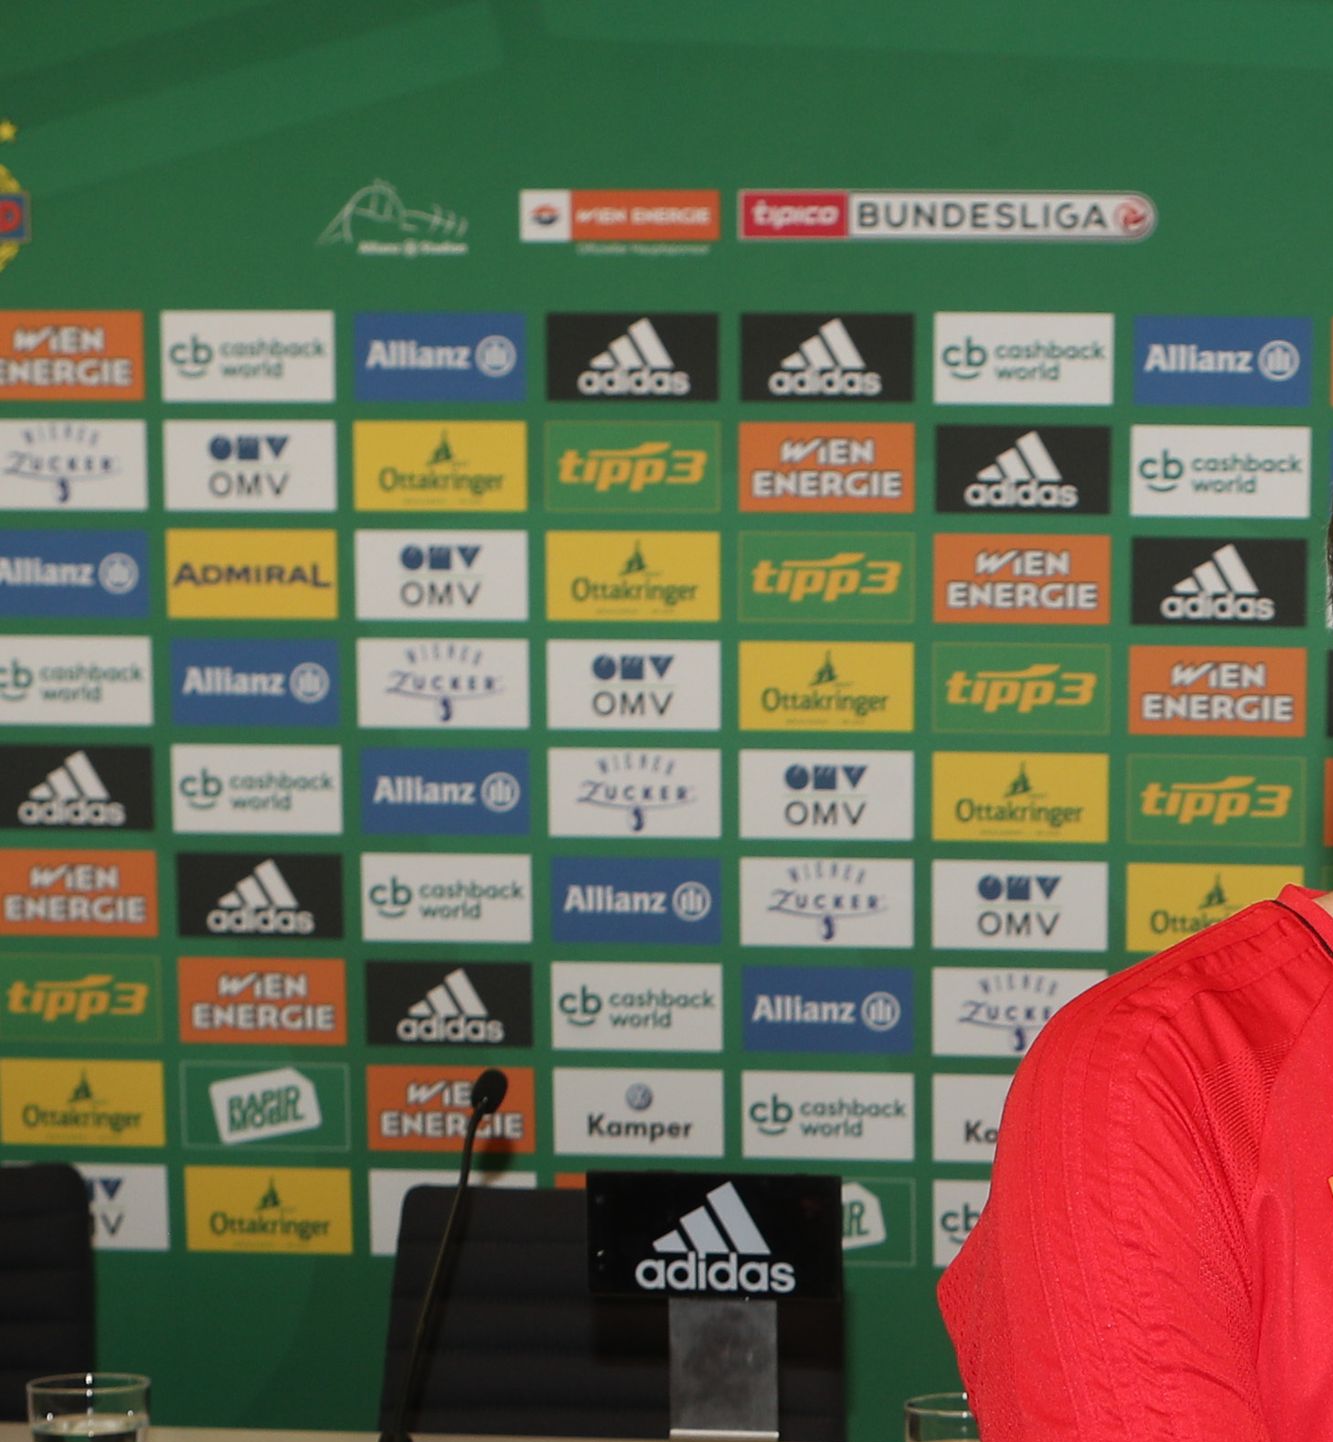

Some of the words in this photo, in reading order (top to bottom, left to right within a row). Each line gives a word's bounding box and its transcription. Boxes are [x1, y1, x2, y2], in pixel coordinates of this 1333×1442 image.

[631, 206, 711, 225] ENERGIE
[752, 201, 840, 229] tipico
[858, 202, 1109, 230] BUNDESLIGA
[13, 327, 104, 353] WIEN
[220, 340, 325, 359] cashback
[994, 341, 1105, 361] cashback
[365, 340, 470, 370] Allianz
[1144, 344, 1253, 373] Allianz
[221, 362, 283, 379] world
[577, 367, 691, 396] adidas
[768, 368, 882, 396] adidas
[996, 364, 1061, 382] world
[781, 439, 873, 465] WIEN
[1191, 455, 1302, 473] cashback
[559, 442, 708, 492] tipp3
[208, 471, 288, 498] OMV
[378, 467, 503, 497] Ottakringer
[753, 471, 901, 497] ENERGIE
[964, 479, 1079, 508] adidas
[1192, 477, 1257, 494] world
[173, 562, 331, 589] ADMIRAL
[753, 552, 902, 602] tipp3
[976, 551, 1069, 576] WIEN
[400, 581, 481, 607] OMV
[570, 577, 698, 607] Ottakringer
[947, 582, 1097, 609] ENERGIE
[1160, 591, 1275, 621] adidas
[182, 666, 285, 696] Allianz
[946, 663, 1097, 713] tipp3
[1172, 663, 1264, 688] WIEN
[592, 690, 673, 717] OMV
[760, 687, 888, 718] Ottakringer
[1143, 694, 1292, 721] ENERGIE
[229, 774, 333, 791] cashback
[373, 775, 475, 805] Allianz
[17, 797, 126, 826] adidas
[231, 794, 292, 811] world
[784, 800, 866, 827] OMV
[954, 795, 1083, 829] Ottakringer
[1141, 776, 1292, 825] tipp3
[30, 865, 118, 890] WIEN
[419, 881, 523, 900] cashback
[4, 895, 143, 922] ENERGIE
[421, 901, 482, 920] world
[564, 885, 667, 914] Allianz
[206, 904, 315, 934] adidas
[977, 910, 1060, 937] OMV
[8, 974, 149, 1022] tipp3
[219, 974, 307, 999] WIEN
[608, 990, 714, 1009] cashback
[192, 1003, 332, 1030] ENERGIE
[609, 1010, 672, 1029] world
[752, 995, 856, 1024] Allianz
[396, 1012, 504, 1043] adidas
[21, 1104, 141, 1134] Ottakringer
[799, 1099, 905, 1118] cashback
[587, 1107, 692, 1142] Kamper
[800, 1120, 863, 1138] world
[209, 1212, 330, 1242] Ottakringer
[635, 1251, 797, 1294] adidas
